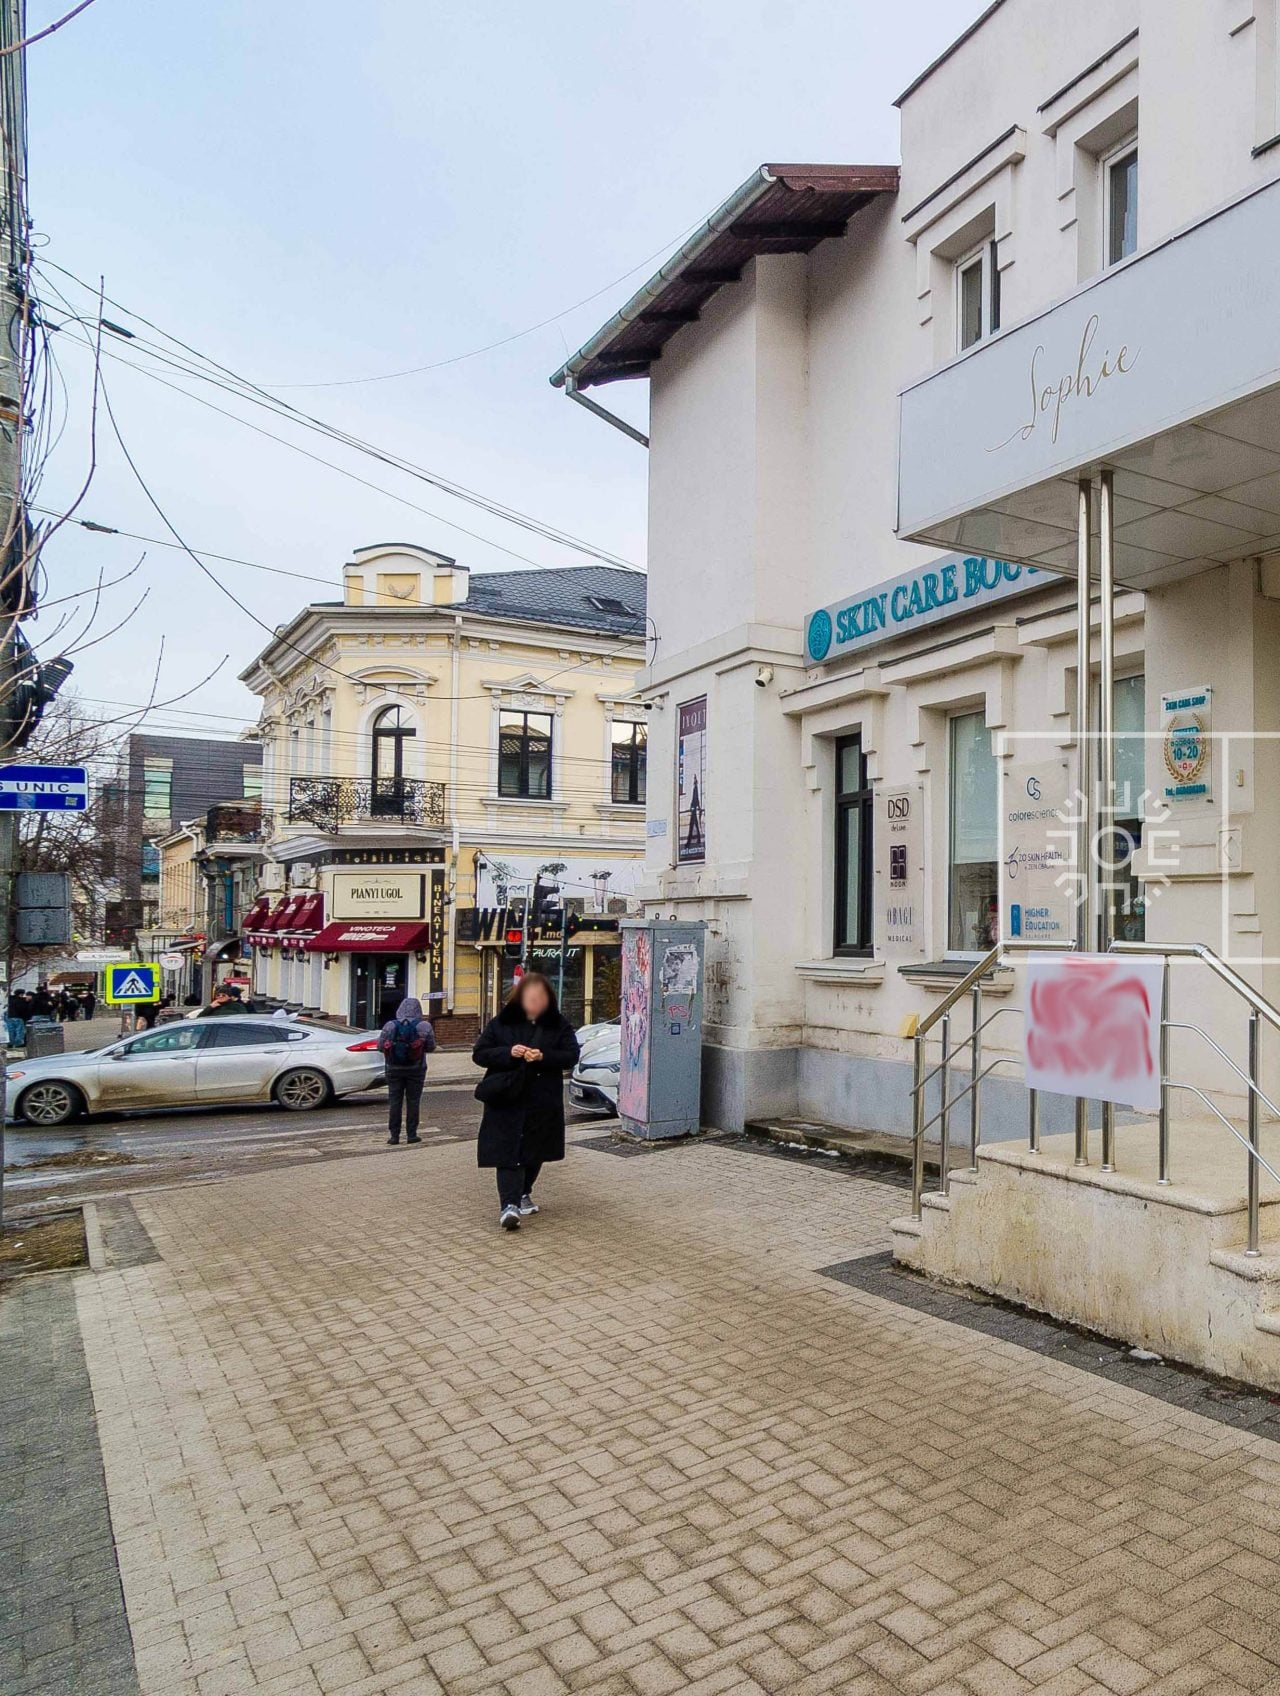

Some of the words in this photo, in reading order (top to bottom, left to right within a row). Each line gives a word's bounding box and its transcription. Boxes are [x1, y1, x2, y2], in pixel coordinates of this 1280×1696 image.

[984, 313, 1141, 453] Sophie
[836, 592, 888, 645] SKIN
[891, 564, 958, 622] CARE
[16, 782, 70, 793] UNIC
[887, 797, 910, 819] DSD
[1027, 852, 1040, 862] SKIN
[1041, 850, 1063, 861] HEALTH
[351, 888, 379, 899] PIANYI
[380, 888, 403, 899] UGOL
[433, 885, 442, 913] BINE
[887, 906, 912, 926] OBAGI
[1024, 907, 1049, 917] HIGHER
[1025, 921, 1060, 930] EDUCATION
[887, 935, 913, 943] MEDICAL
[432, 942, 442, 979] VENIT
